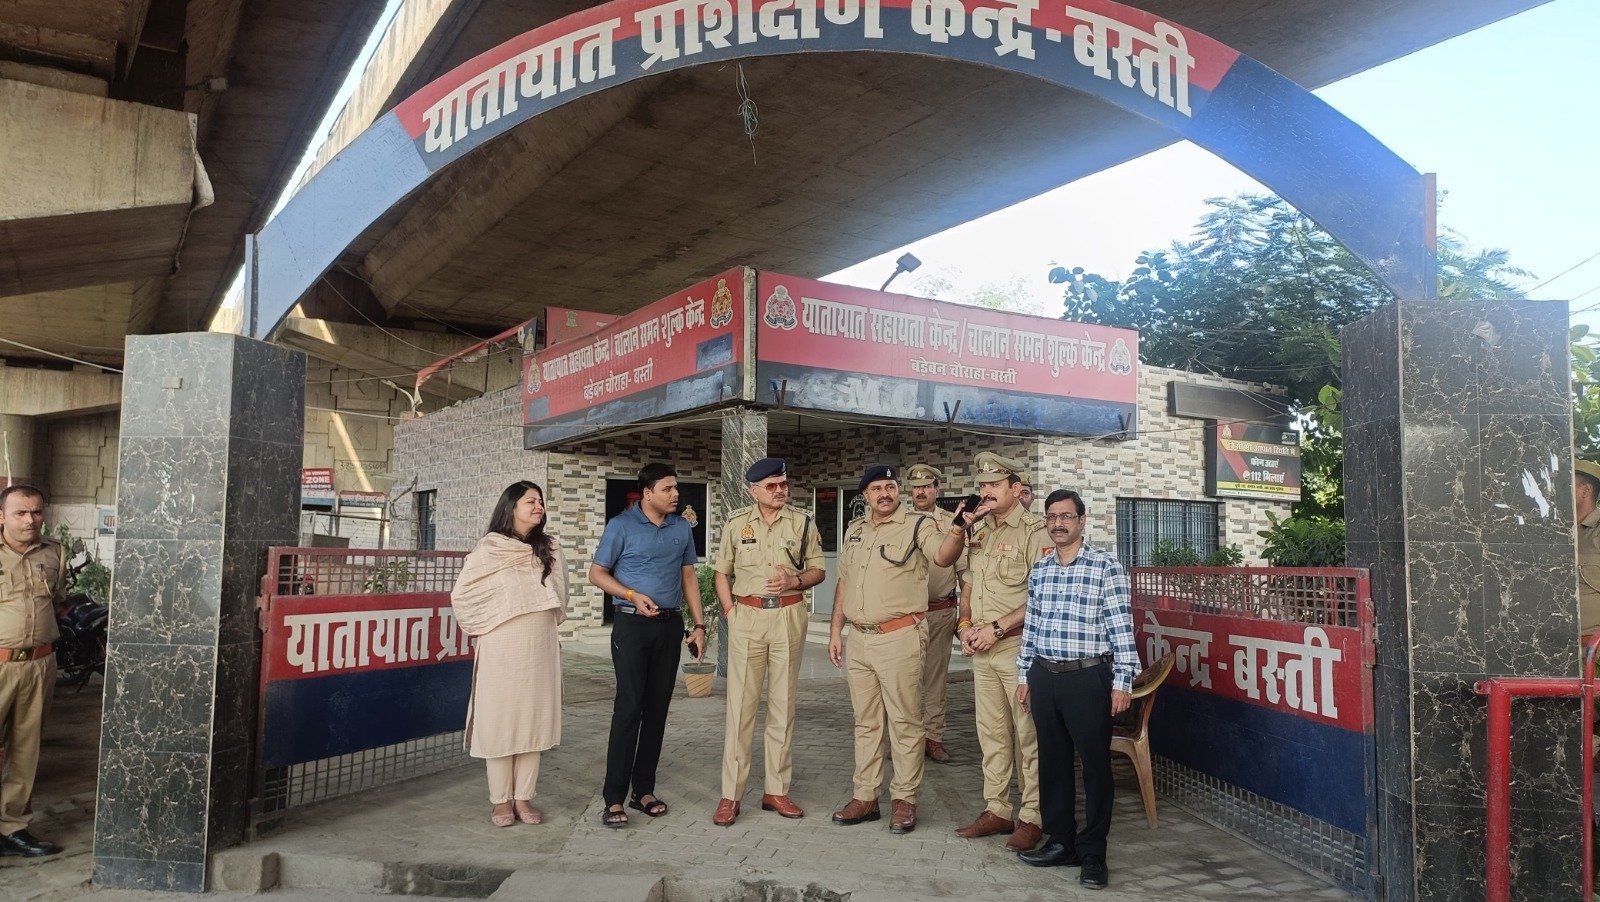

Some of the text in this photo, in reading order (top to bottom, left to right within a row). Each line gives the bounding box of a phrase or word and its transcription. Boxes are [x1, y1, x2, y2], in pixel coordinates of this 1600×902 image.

[423, 17, 621, 153] यातायात
[1066, 5, 1195, 118] बस्ती
[543, 354, 569, 383] यातायात
[568, 344, 595, 374] सहायता
[639, 317, 660, 348] समन
[661, 307, 684, 348] शुल्क
[684, 295, 705, 330] केन्द्र
[633, 357, 653, 384] बस्ती
[801, 297, 868, 341] यातायात
[869, 307, 926, 349] सहायता
[1013, 329, 1046, 365] समन
[1046, 334, 1080, 378] शुल्क
[1080, 331, 1108, 374] केन्द्र
[305, 475, 331, 484] ZONE
[1250, 470, 1262, 481] 112
[283, 607, 434, 674] यातायात
[1228, 626, 1342, 720] बस्ती
